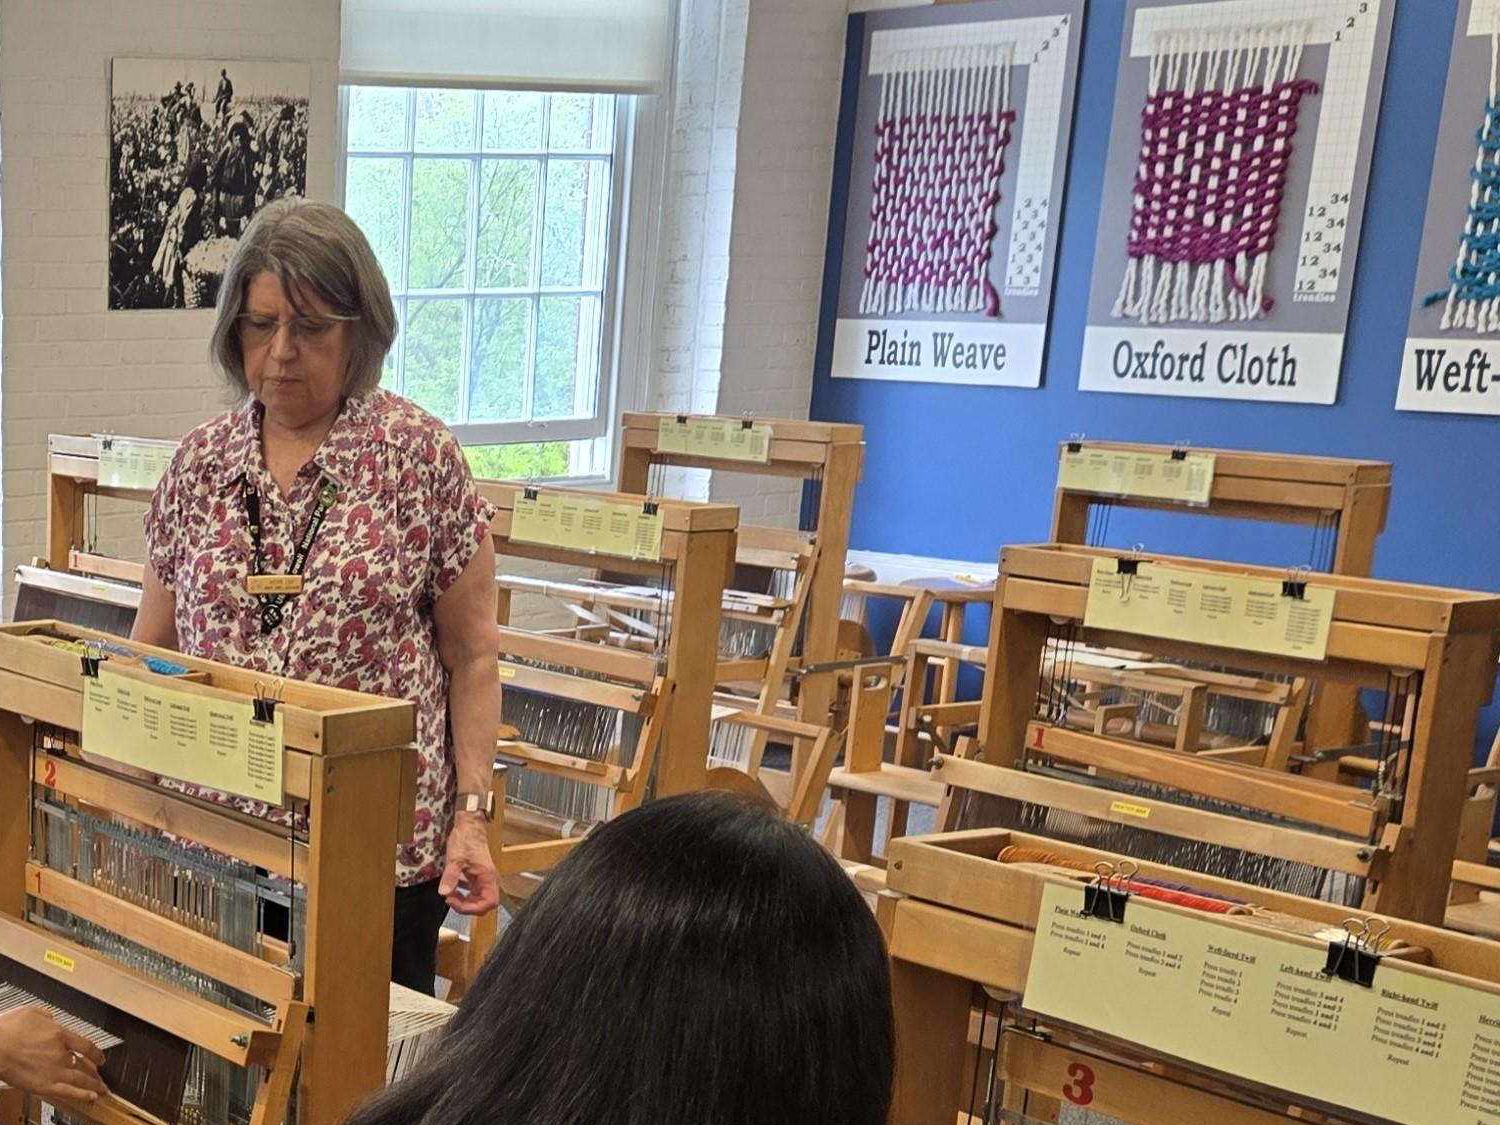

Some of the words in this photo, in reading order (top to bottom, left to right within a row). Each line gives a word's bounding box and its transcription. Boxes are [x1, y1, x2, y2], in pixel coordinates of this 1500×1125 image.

[1359, 2, 1368, 13] 3
[1061, 16, 1068, 25] 4
[1346, 16, 1355, 28] 2
[1053, 27, 1060, 38] 3
[1335, 30, 1341, 42] 1
[1042, 40, 1049, 51] 2
[1034, 52, 1038, 63] 1
[864, 328, 922, 366] Plain
[932, 331, 1007, 371] Weave
[1113, 340, 1208, 383] Oxford
[1217, 342, 1297, 386] Cloth
[1414, 347, 1500, 394] Weft-
[301, 516, 320, 549] National
[1033, 727, 1045, 749] 1
[45, 759, 57, 788] 2
[35, 871, 41, 894] 1
[1063, 1062, 1096, 1106] 3
